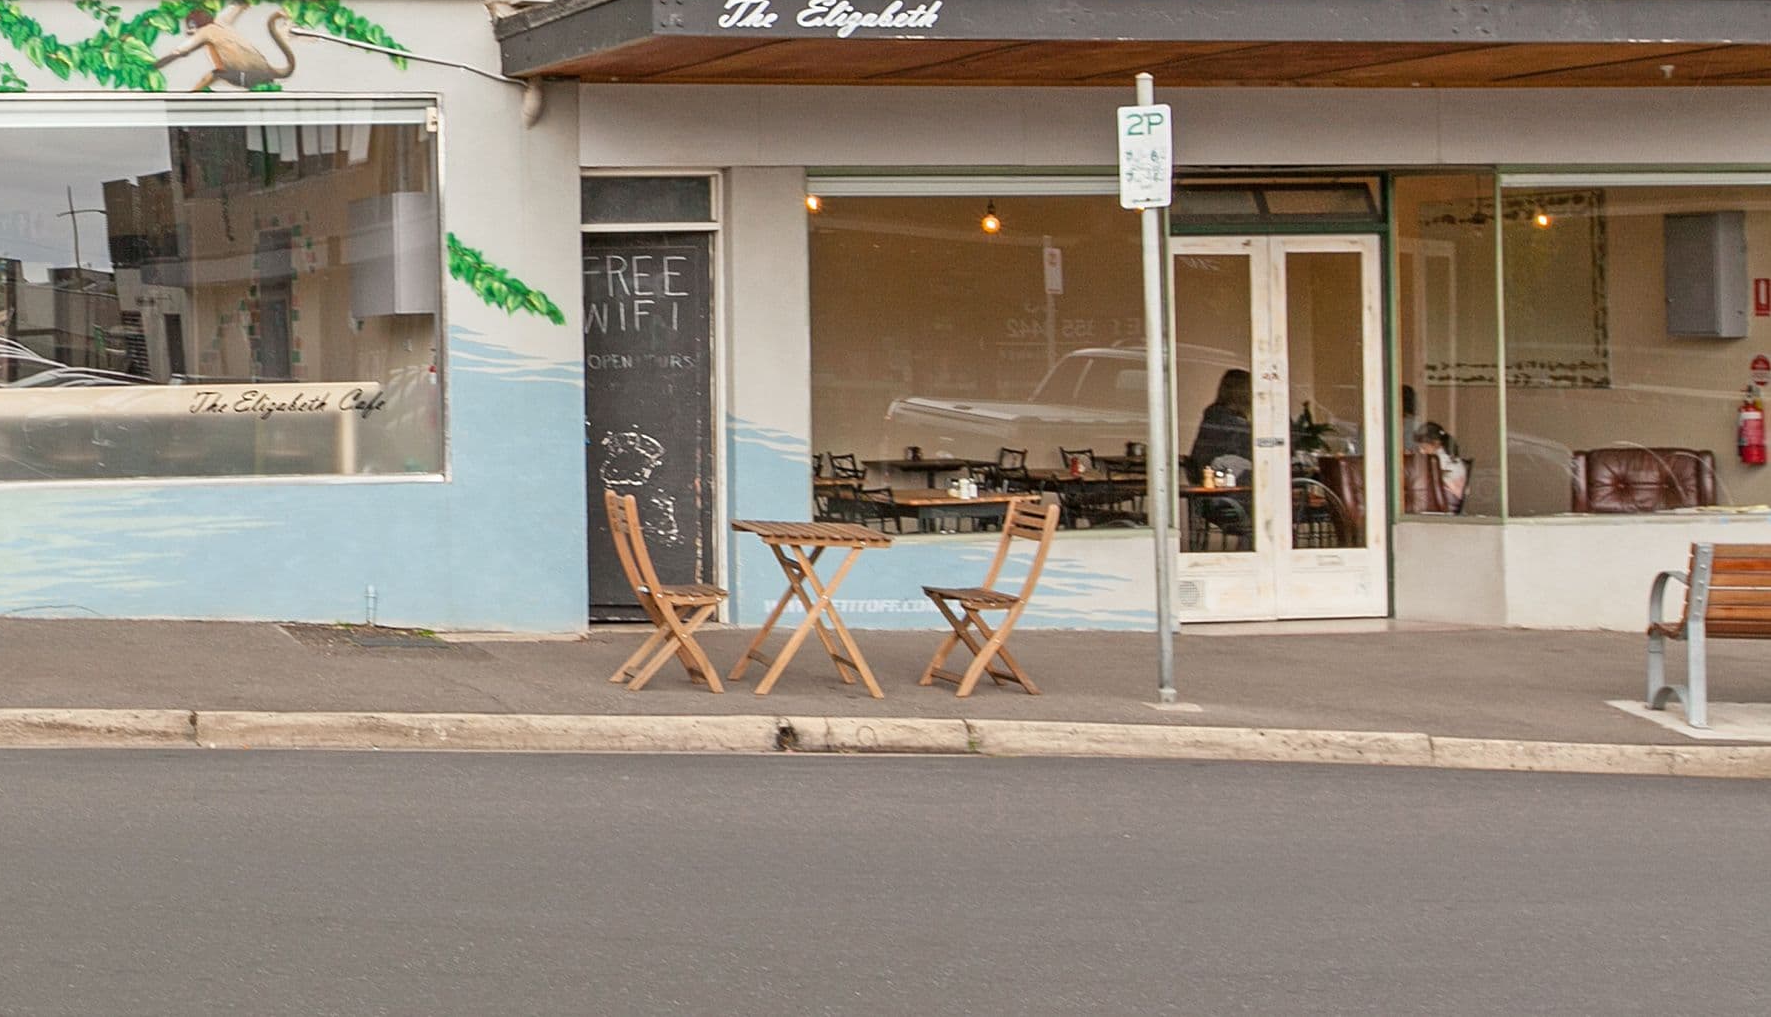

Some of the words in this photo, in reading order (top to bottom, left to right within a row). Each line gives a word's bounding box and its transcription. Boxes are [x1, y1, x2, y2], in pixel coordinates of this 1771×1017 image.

[1126, 112, 1164, 135] 2P
[587, 353, 633, 370] OPEN
[190, 391, 227, 414] The
[233, 390, 330, 420] Elizabeth
[339, 388, 386, 419] Cafe
